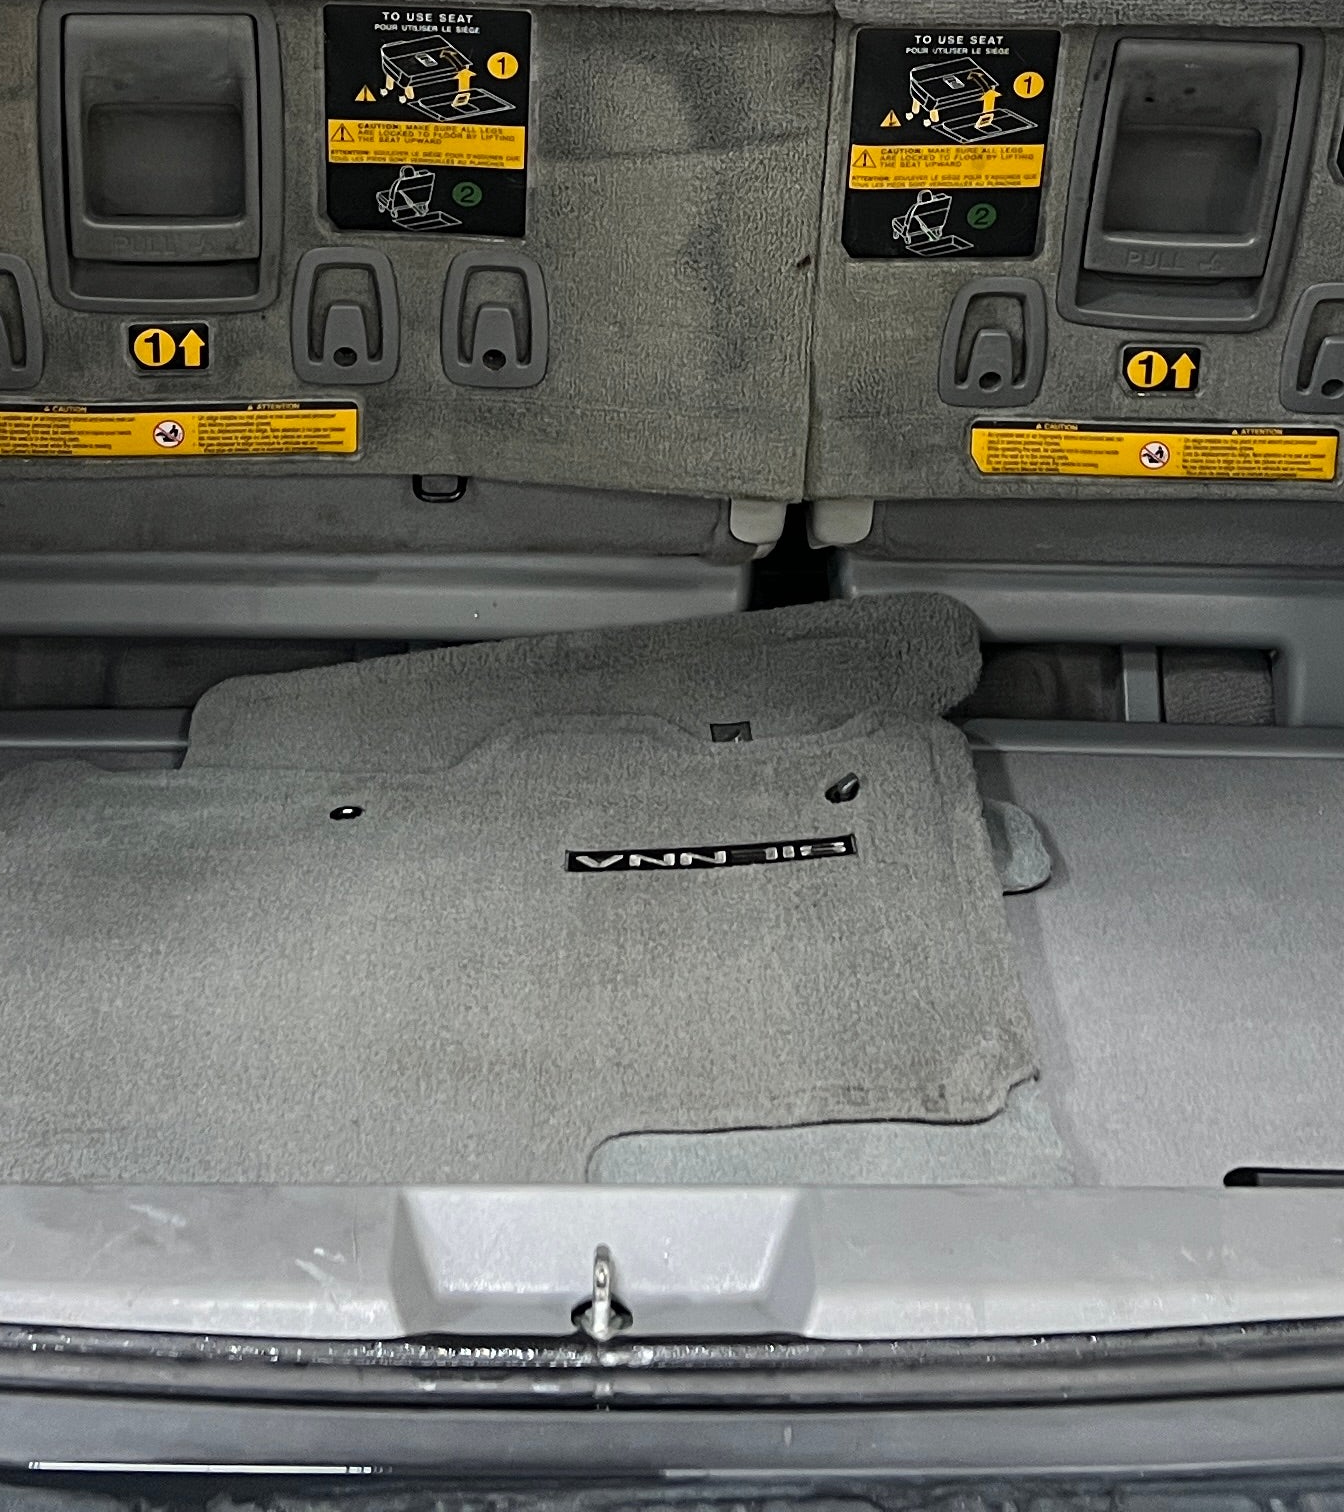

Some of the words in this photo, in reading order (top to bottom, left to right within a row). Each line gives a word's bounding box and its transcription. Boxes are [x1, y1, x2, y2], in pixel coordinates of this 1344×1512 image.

[382, 11, 401, 22] TO
[406, 12, 433, 22] USE
[439, 13, 474, 24] SEAT
[374, 23, 397, 31] POUR
[401, 24, 438, 32] UTILISER
[441, 25, 452, 33] LE
[915, 35, 932, 45] TO
[938, 35, 964, 45] USE
[970, 35, 1004, 45] SEAT
[932, 47, 968, 55] UTILISER
[971, 47, 981, 55] LE
[1126, 250, 1185, 270] PULL
[52, 405, 88, 413] CAUTION
[256, 402, 300, 410] ATTENTION
[1044, 423, 1078, 431] CAUTION
[1240, 428, 1283, 436] ATTENTION
